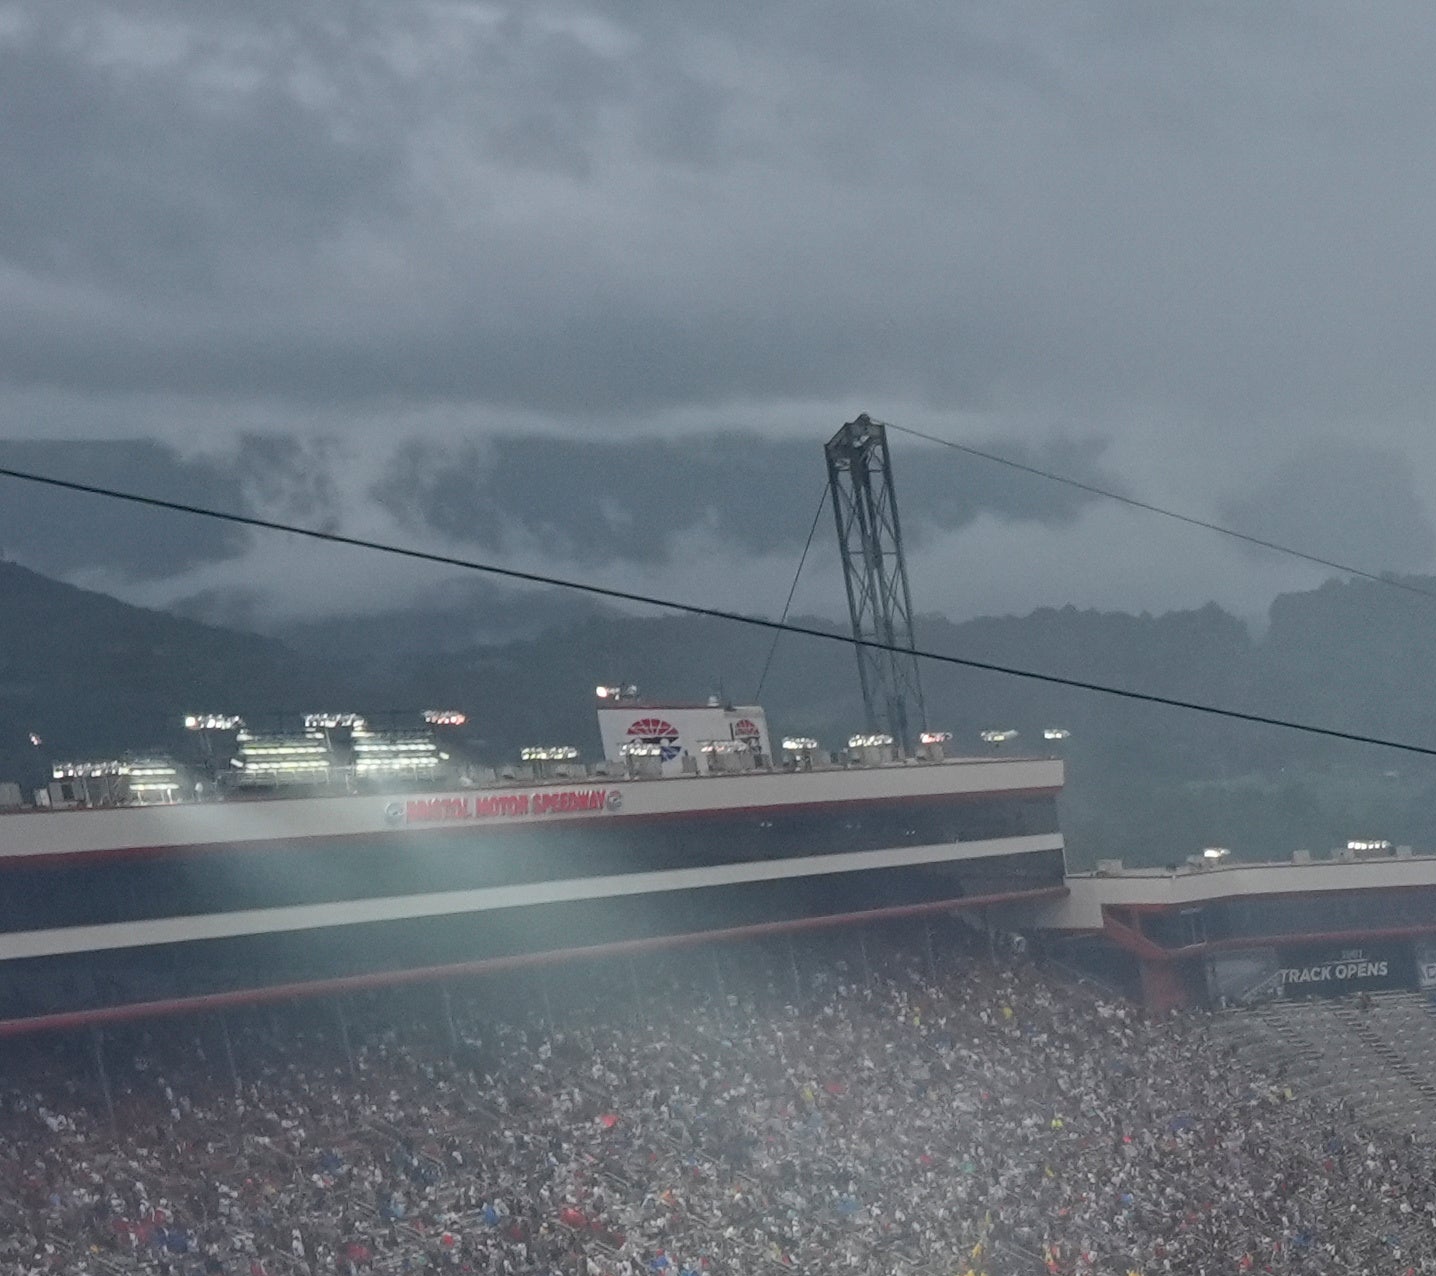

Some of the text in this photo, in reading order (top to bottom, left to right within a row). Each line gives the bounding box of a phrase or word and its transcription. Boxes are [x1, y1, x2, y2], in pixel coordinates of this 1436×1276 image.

[475, 796, 530, 818] MOTOR
[531, 790, 606, 814] SPEEDWAY
[1279, 962, 1388, 983] TRACK OPENS
